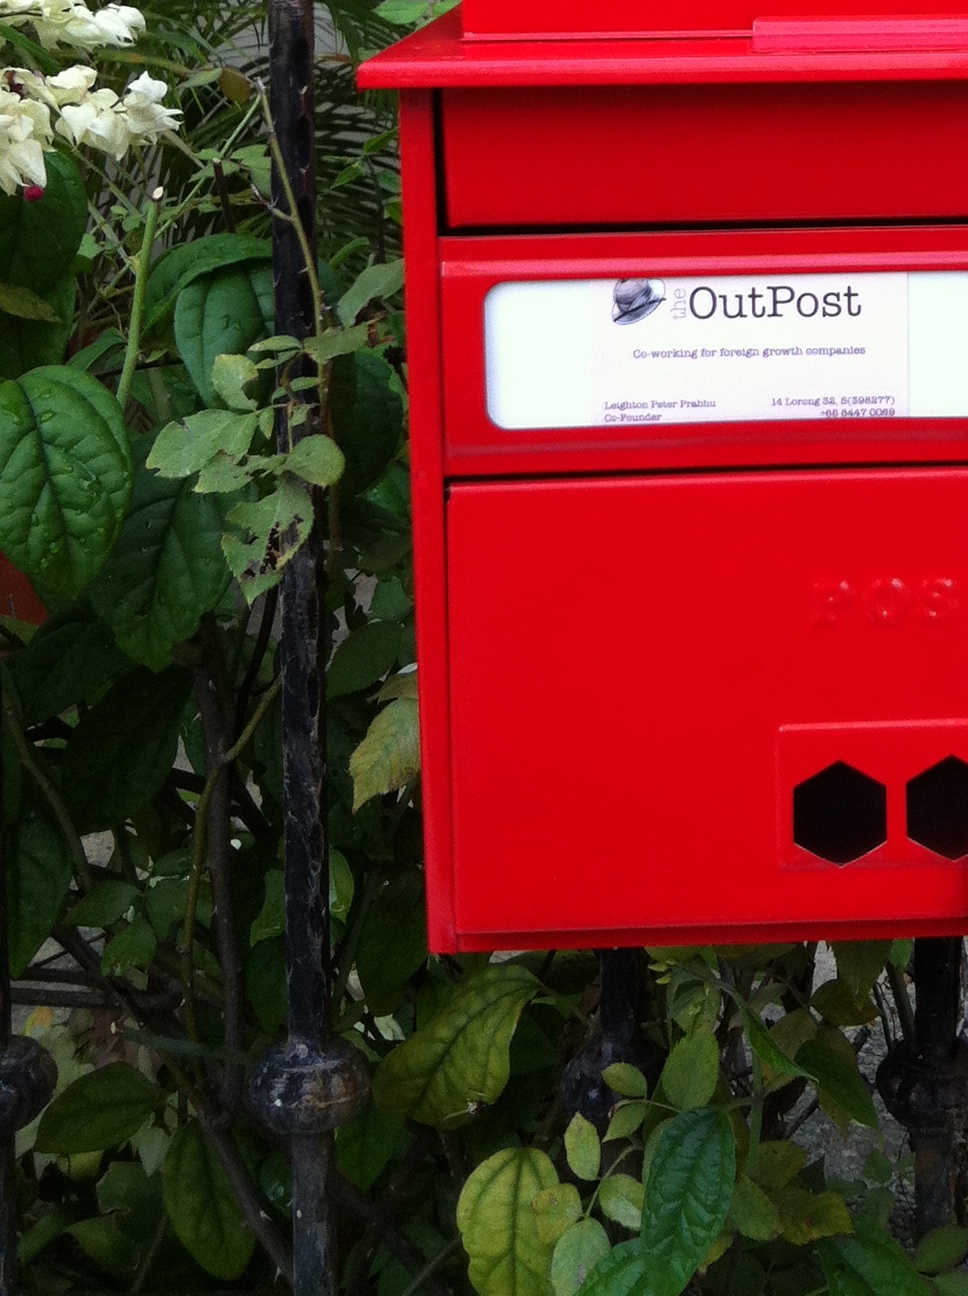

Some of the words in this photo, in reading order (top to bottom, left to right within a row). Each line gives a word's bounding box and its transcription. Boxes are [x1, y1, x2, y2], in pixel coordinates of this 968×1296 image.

[670, 287, 687, 320] the
[689, 285, 862, 319] OutPost
[633, 348, 698, 360] Co-working
[700, 348, 717, 358] for
[719, 348, 760, 359] foreign
[762, 346, 803, 359] growth
[805, 346, 866, 359] companies
[604, 401, 649, 411] Leighton
[651, 400, 678, 409] Peter
[680, 399, 716, 408] Prabhu
[785, 397, 821, 407] Lorong
[604, 413, 662, 422] Co-Founder
